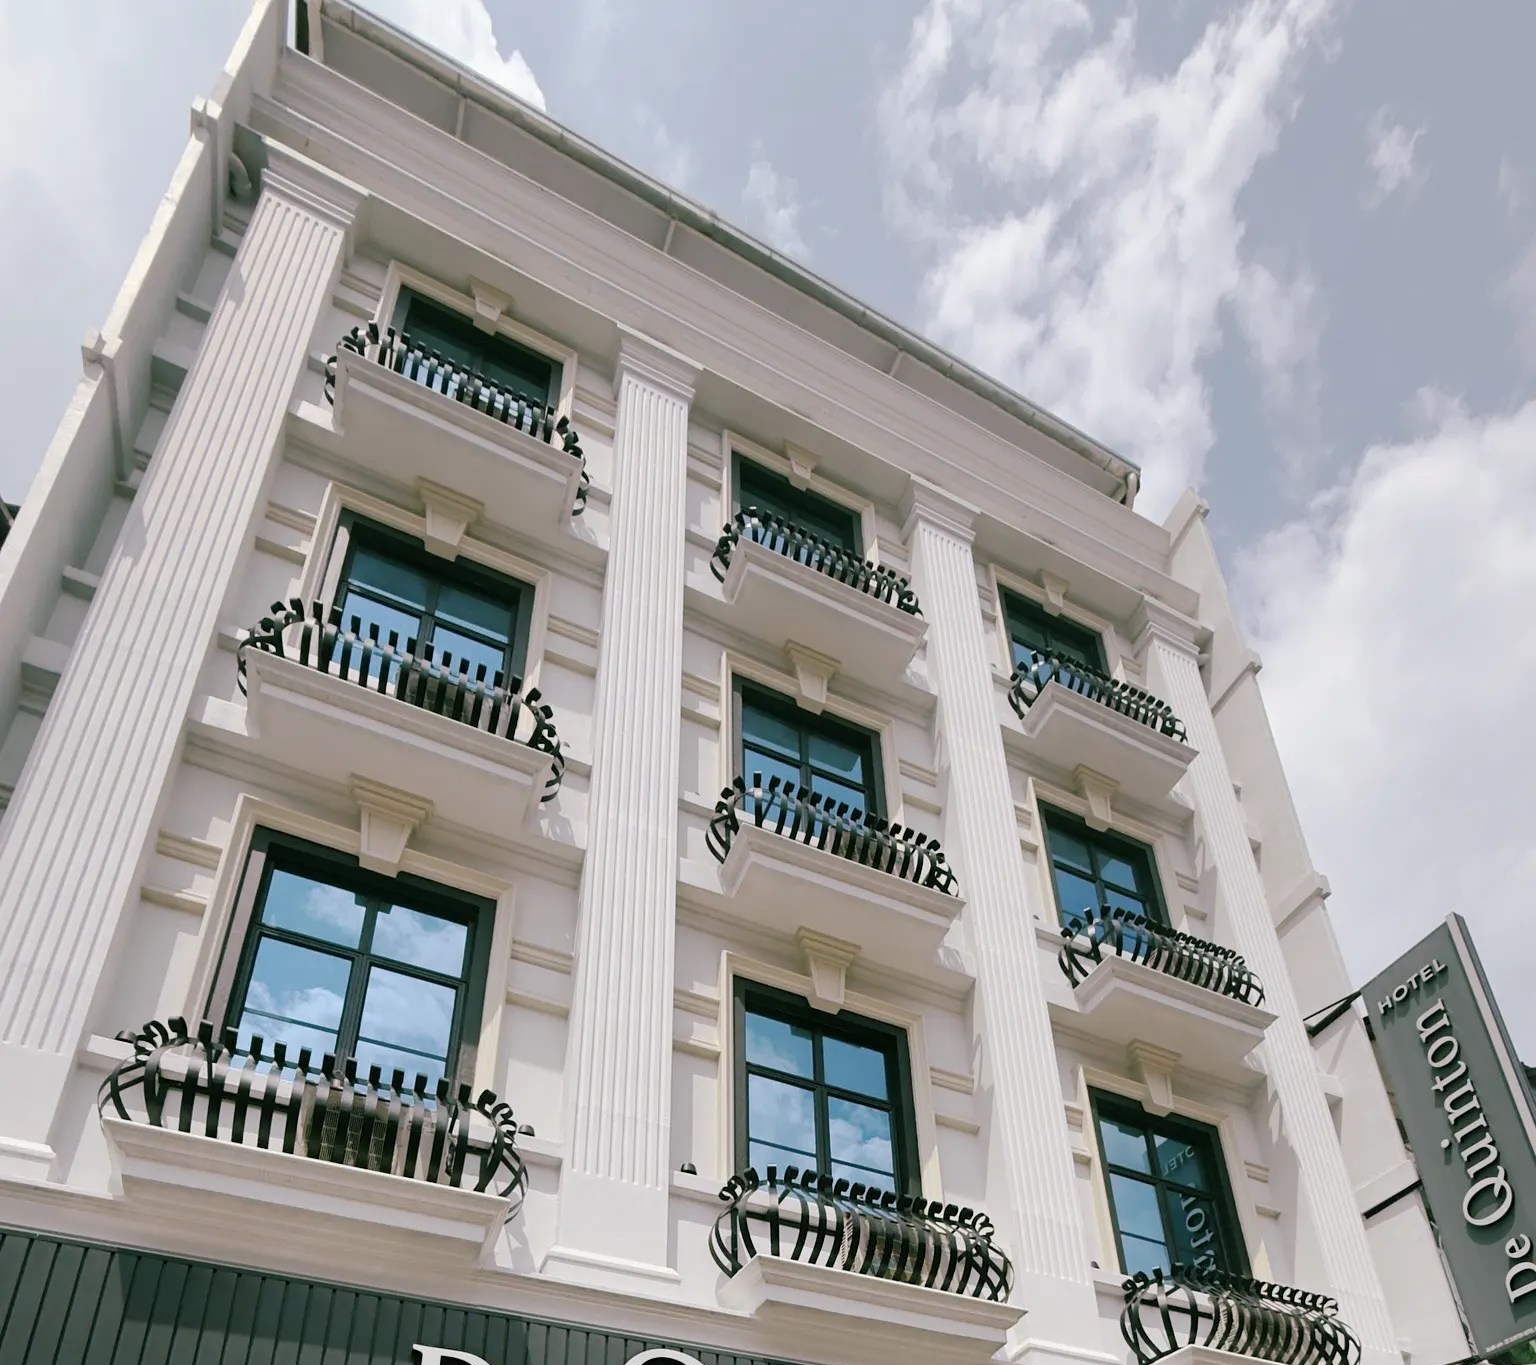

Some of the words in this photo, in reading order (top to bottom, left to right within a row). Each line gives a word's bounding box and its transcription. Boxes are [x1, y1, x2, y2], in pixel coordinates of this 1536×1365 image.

[1376, 958, 1446, 1014] HOTEL
[1415, 998, 1513, 1227] Quinton
[1505, 1233, 1536, 1304] De
